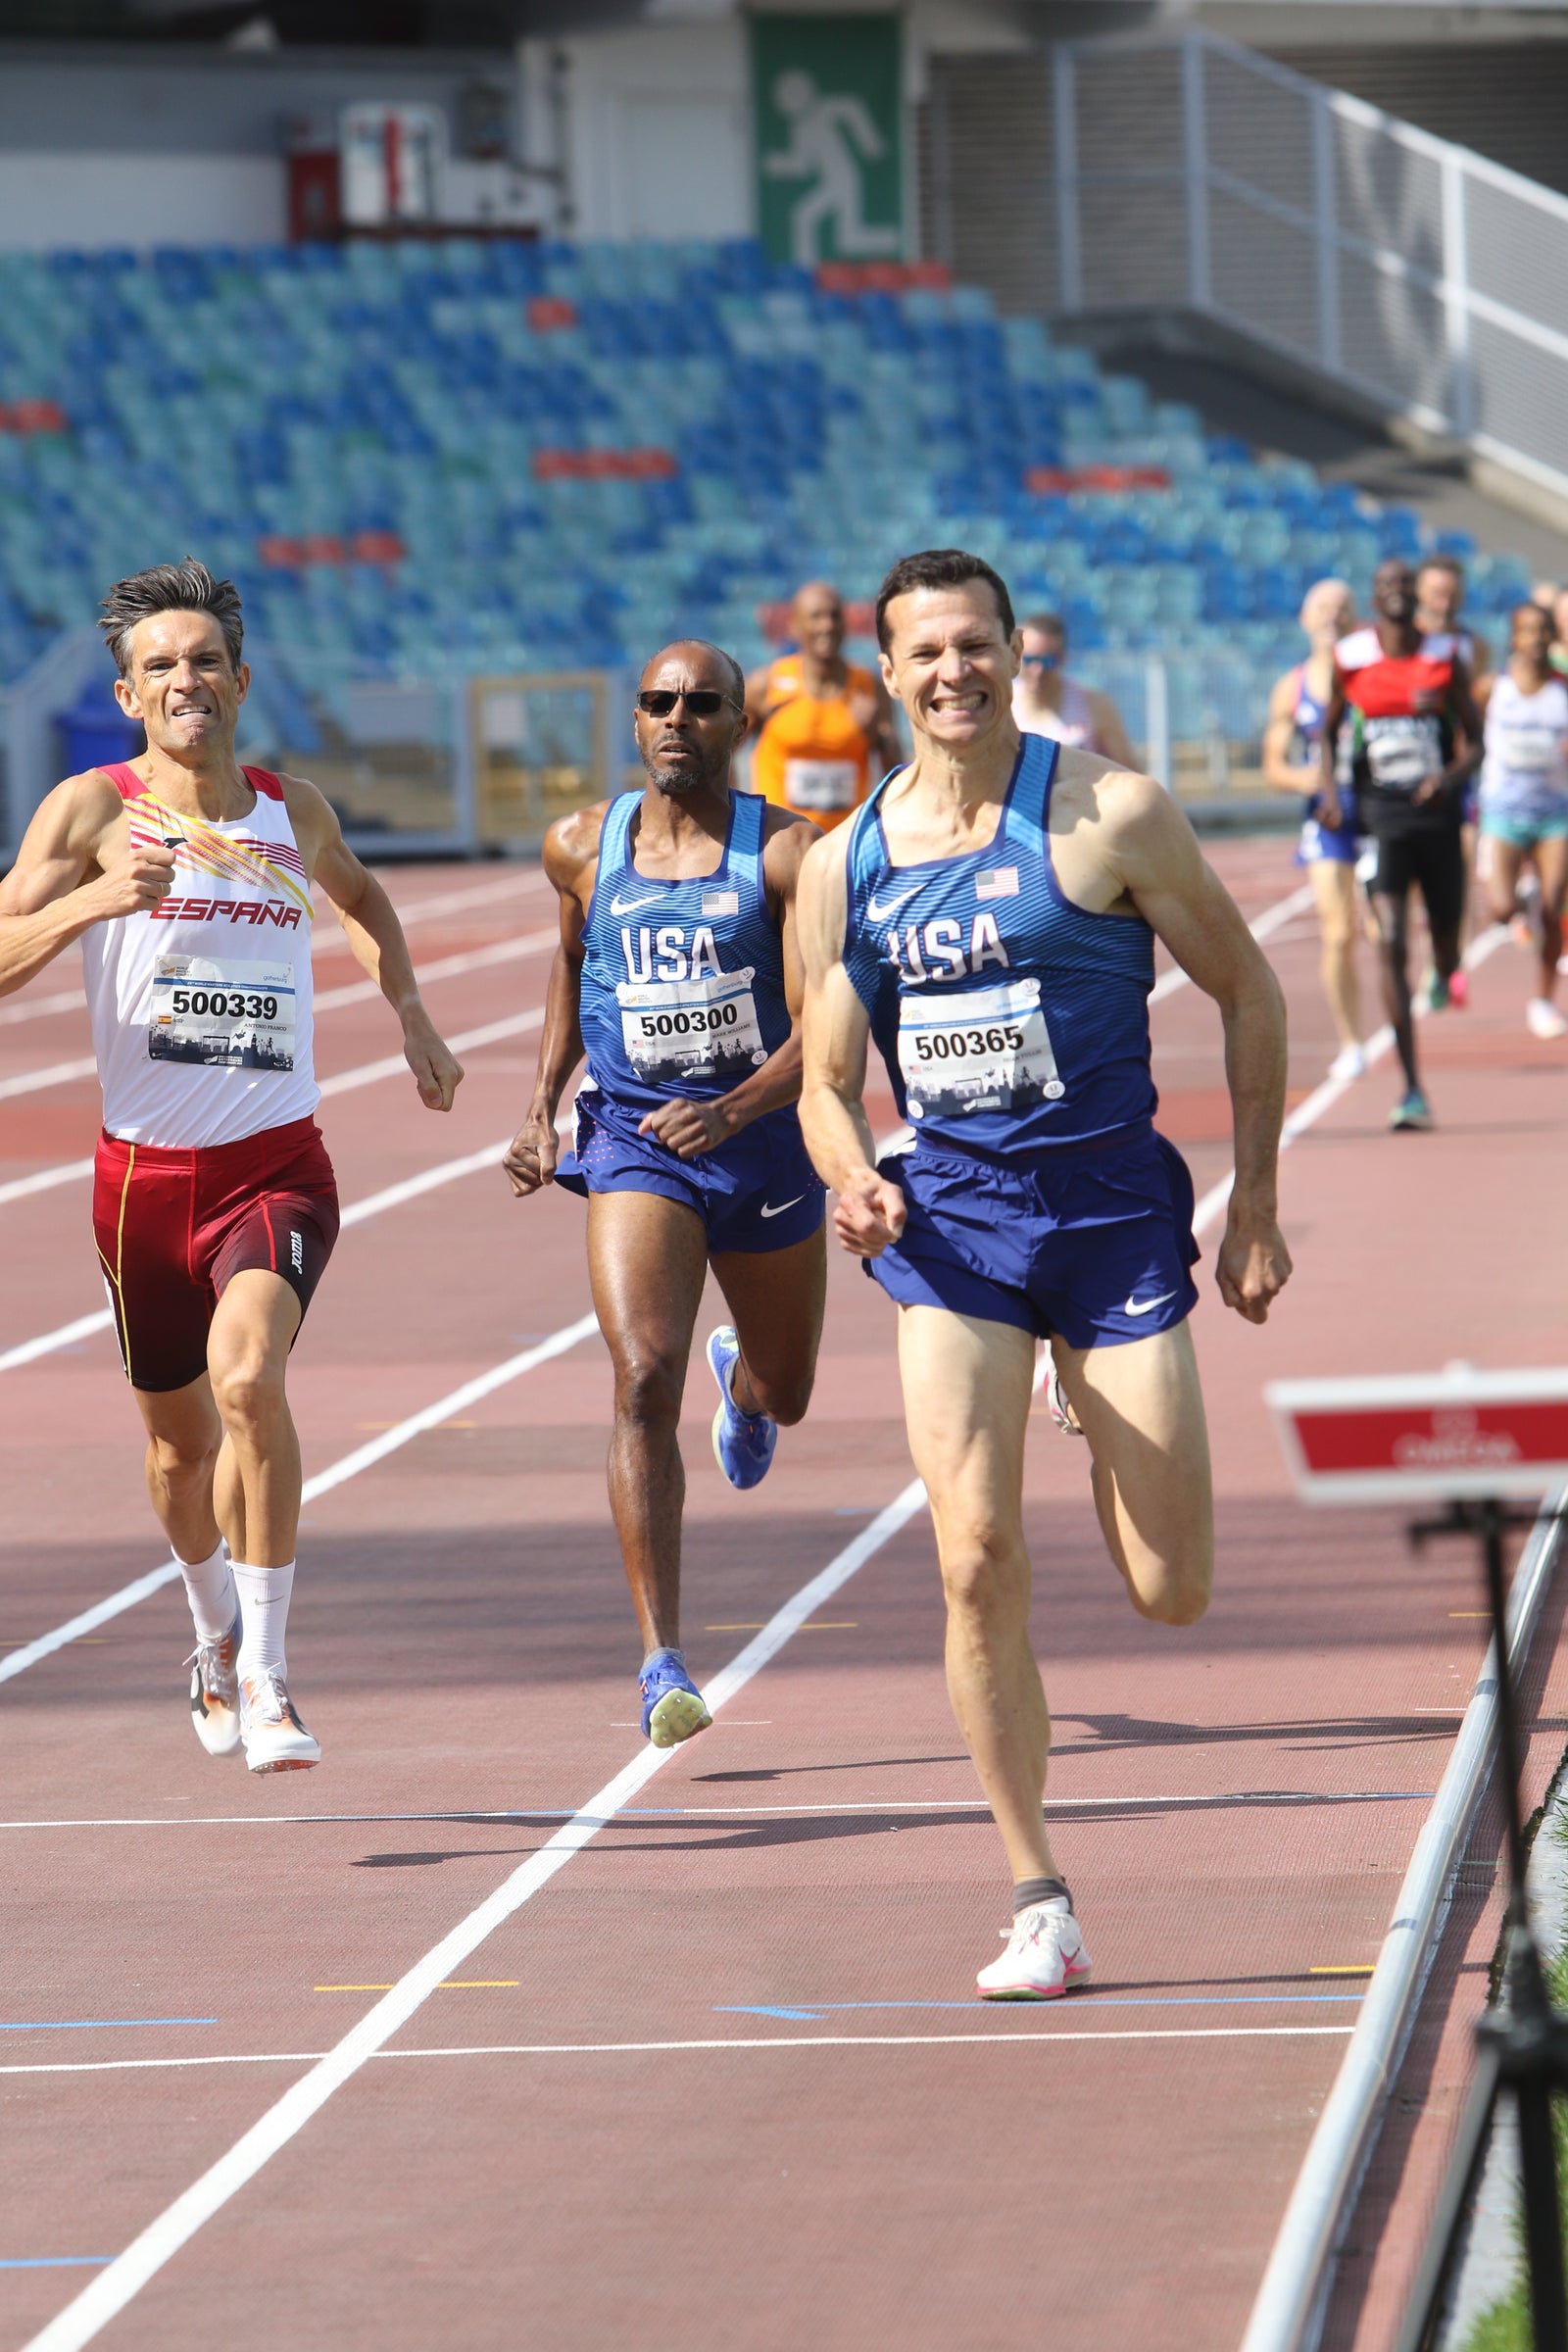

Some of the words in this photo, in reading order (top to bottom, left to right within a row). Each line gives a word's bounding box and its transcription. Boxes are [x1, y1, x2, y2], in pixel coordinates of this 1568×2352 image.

[149, 897, 303, 931] ESPAÑA
[620, 926, 727, 984] USA
[887, 912, 1010, 986] USA
[172, 990, 277, 1020] 500339
[640, 1003, 738, 1038] 500300
[915, 1024, 1024, 1061] 500365
